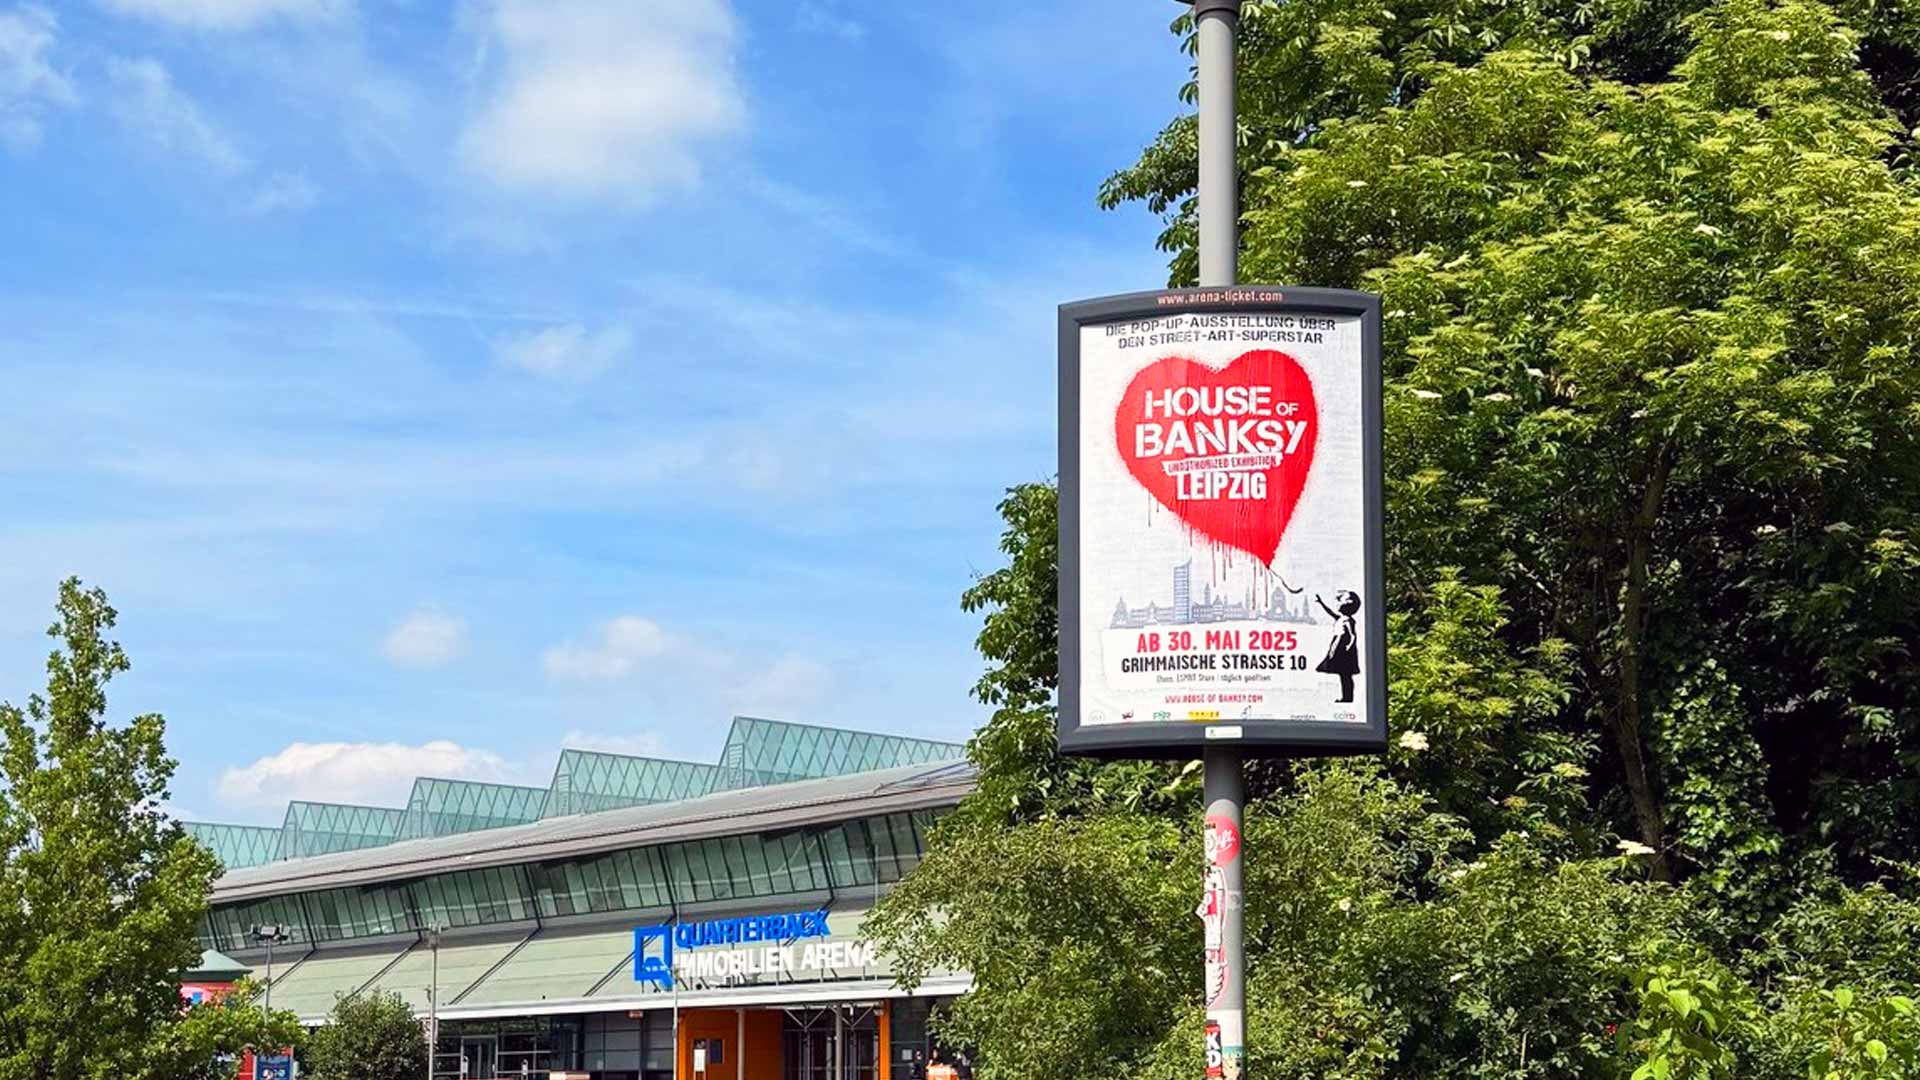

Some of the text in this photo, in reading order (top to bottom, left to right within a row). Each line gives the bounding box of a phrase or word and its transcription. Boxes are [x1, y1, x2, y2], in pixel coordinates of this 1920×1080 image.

[1157, 290, 1282, 305] www.arena-ticket.com
[1106, 316, 1335, 337] DIE POP-UP-AUSSTELLUNG ÜBER
[1118, 330, 1322, 349] DEN STREET-ART-SUPERSTAR
[1145, 386, 1299, 419] HOUSE OF
[1135, 419, 1307, 458] BANKSY
[1177, 472, 1267, 500] LEIPZIG
[1137, 630, 1297, 653] AB 30. MAI 2025
[1121, 654, 1307, 673] GRIMMAISCHE STRASSE 10
[674, 909, 831, 949] QUARTERBACK
[801, 940, 880, 969] ARENA
